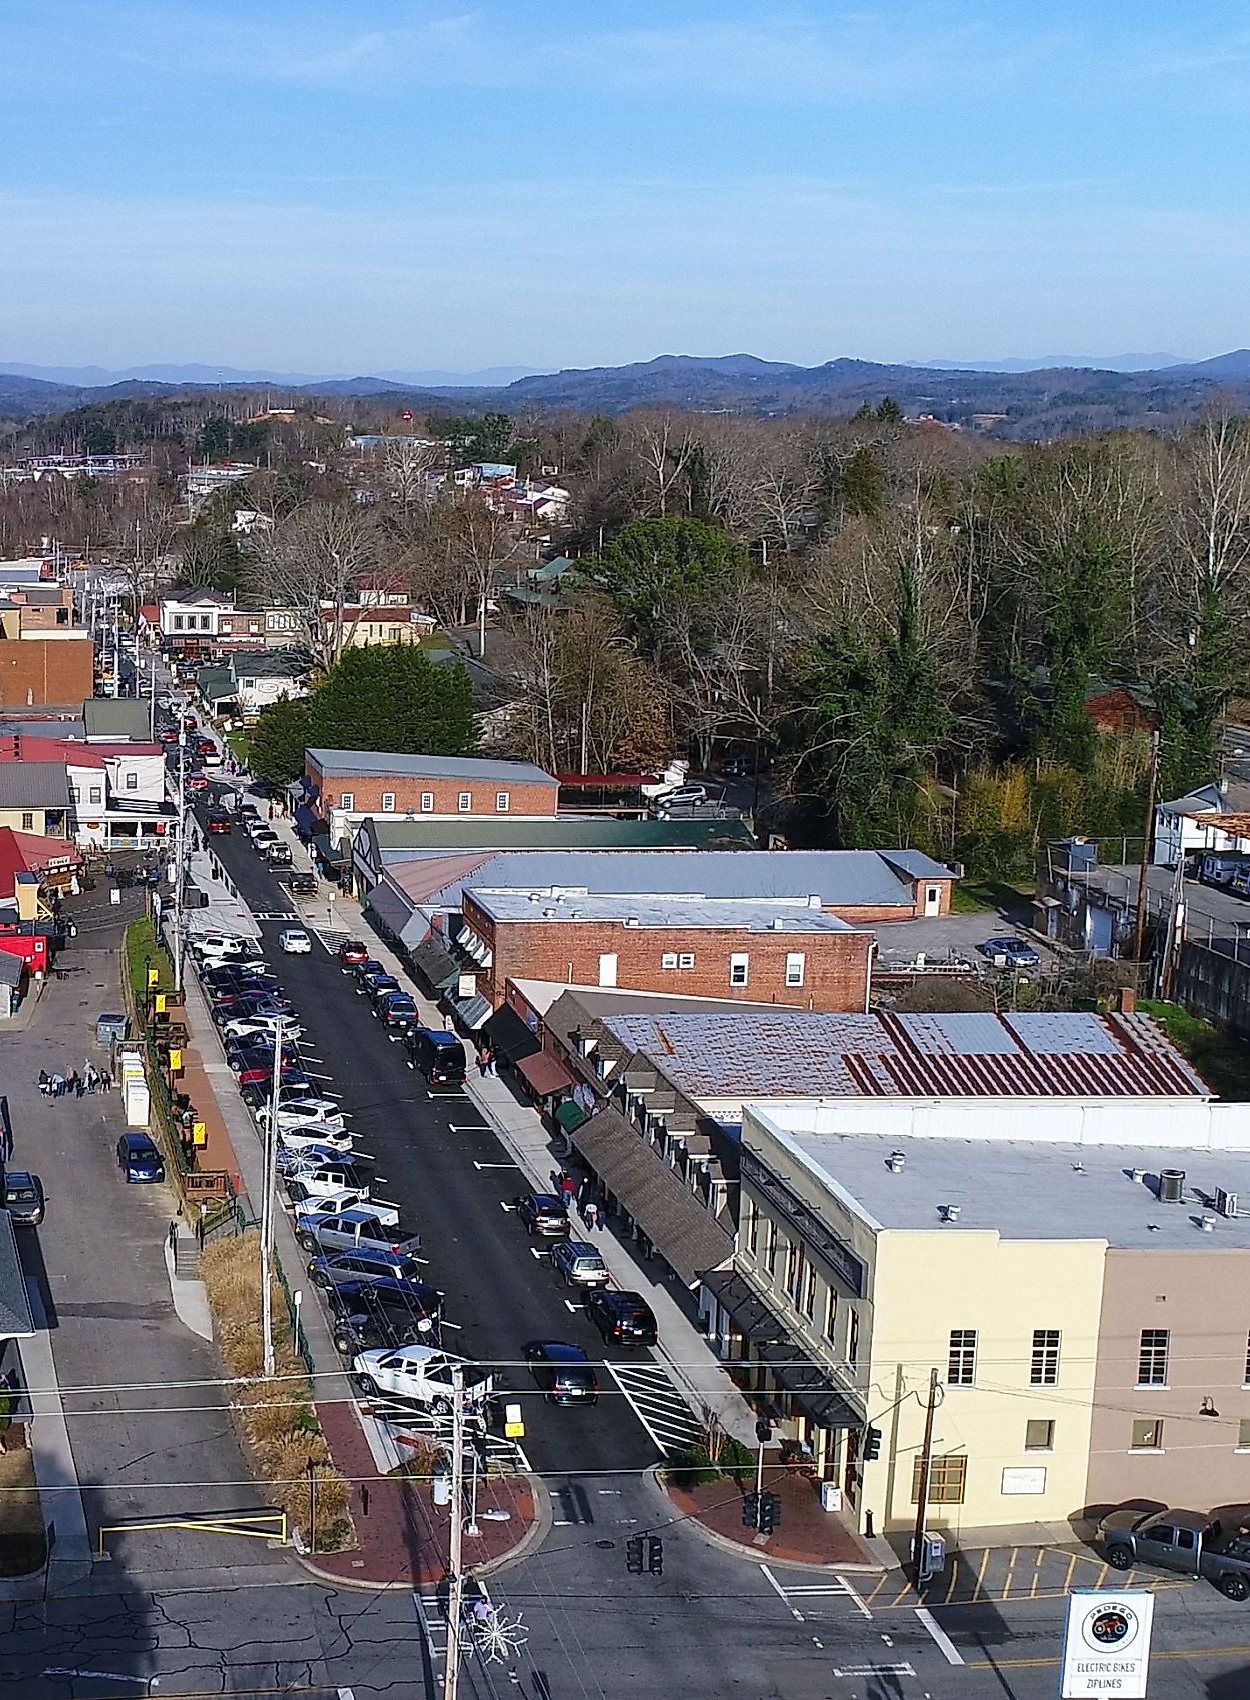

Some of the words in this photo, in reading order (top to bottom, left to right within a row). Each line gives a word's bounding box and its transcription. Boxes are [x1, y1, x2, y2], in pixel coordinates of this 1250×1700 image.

[1077, 1662, 1112, 1672] ELECTRIC
[1113, 1662, 1136, 1672] BIKES
[1086, 1678, 1122, 1688] ZIPLINES
